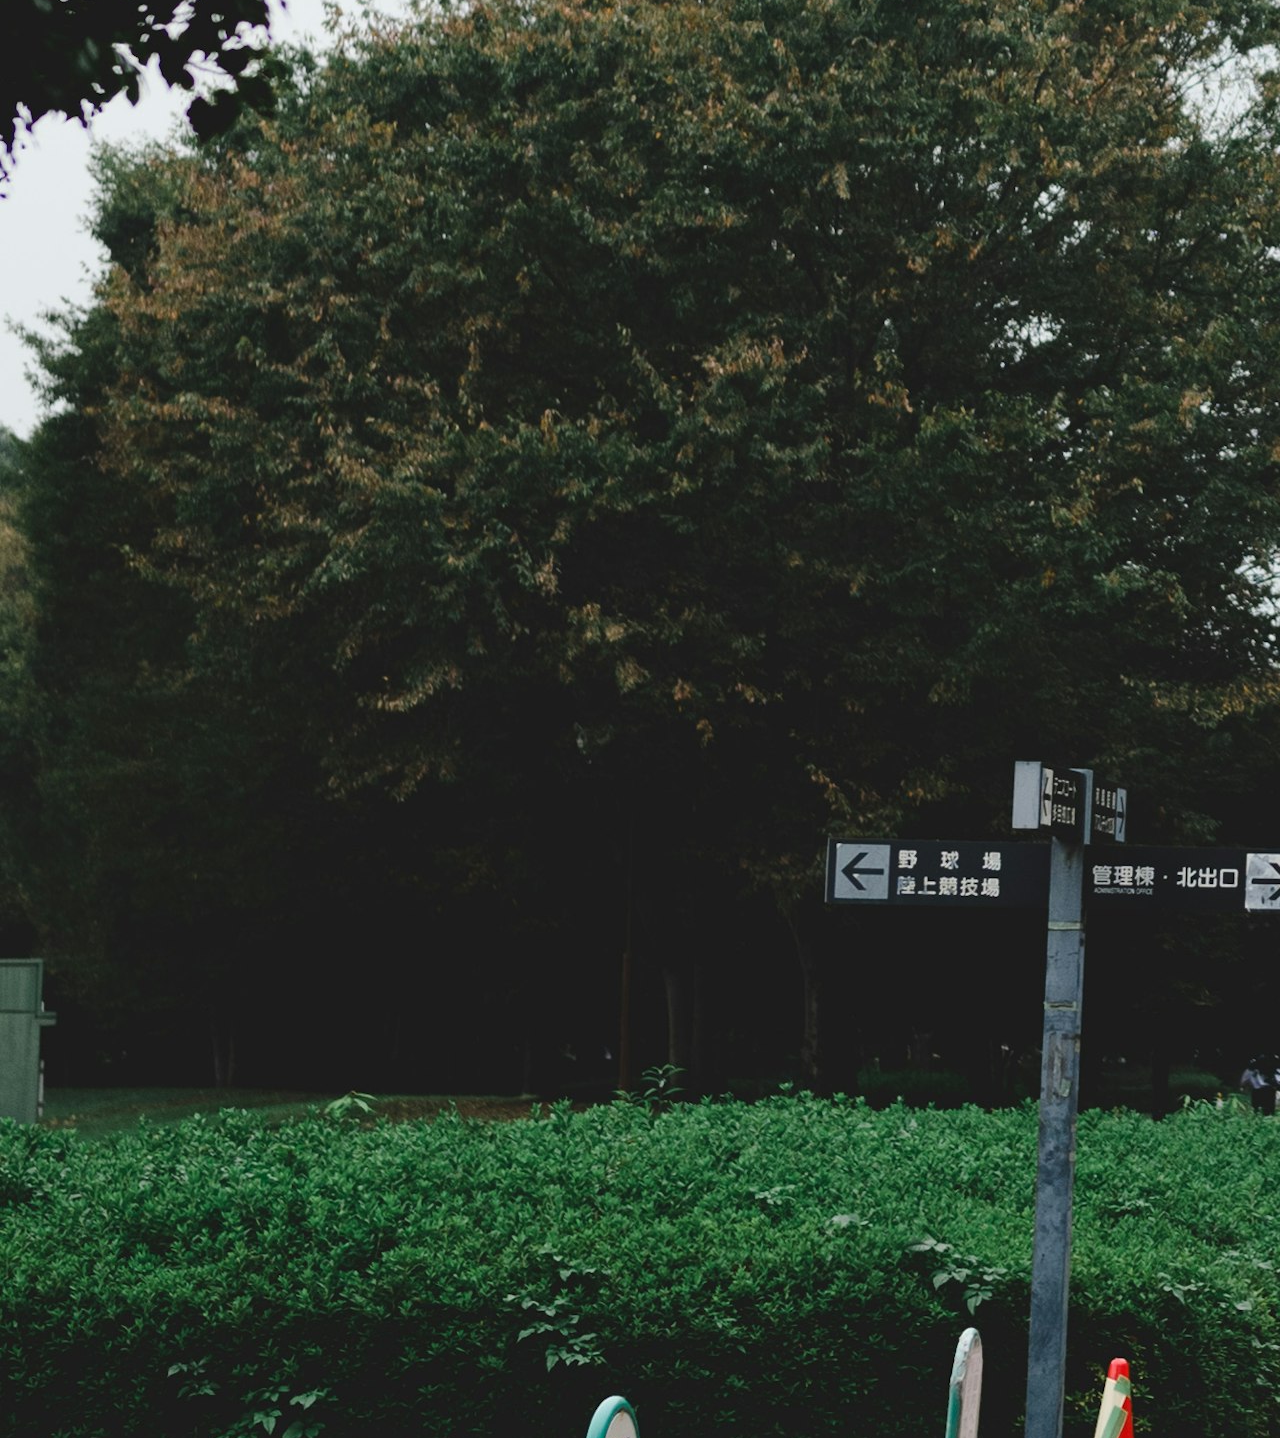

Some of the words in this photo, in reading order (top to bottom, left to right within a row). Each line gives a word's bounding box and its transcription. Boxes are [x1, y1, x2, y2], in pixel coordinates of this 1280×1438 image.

[898, 850, 1002, 871] 野球場
[896, 876, 1000, 897] 陸上競技場
[1094, 887, 1135, 896] ADMINISTRATION
[1136, 888, 1154, 897] OFFICE
